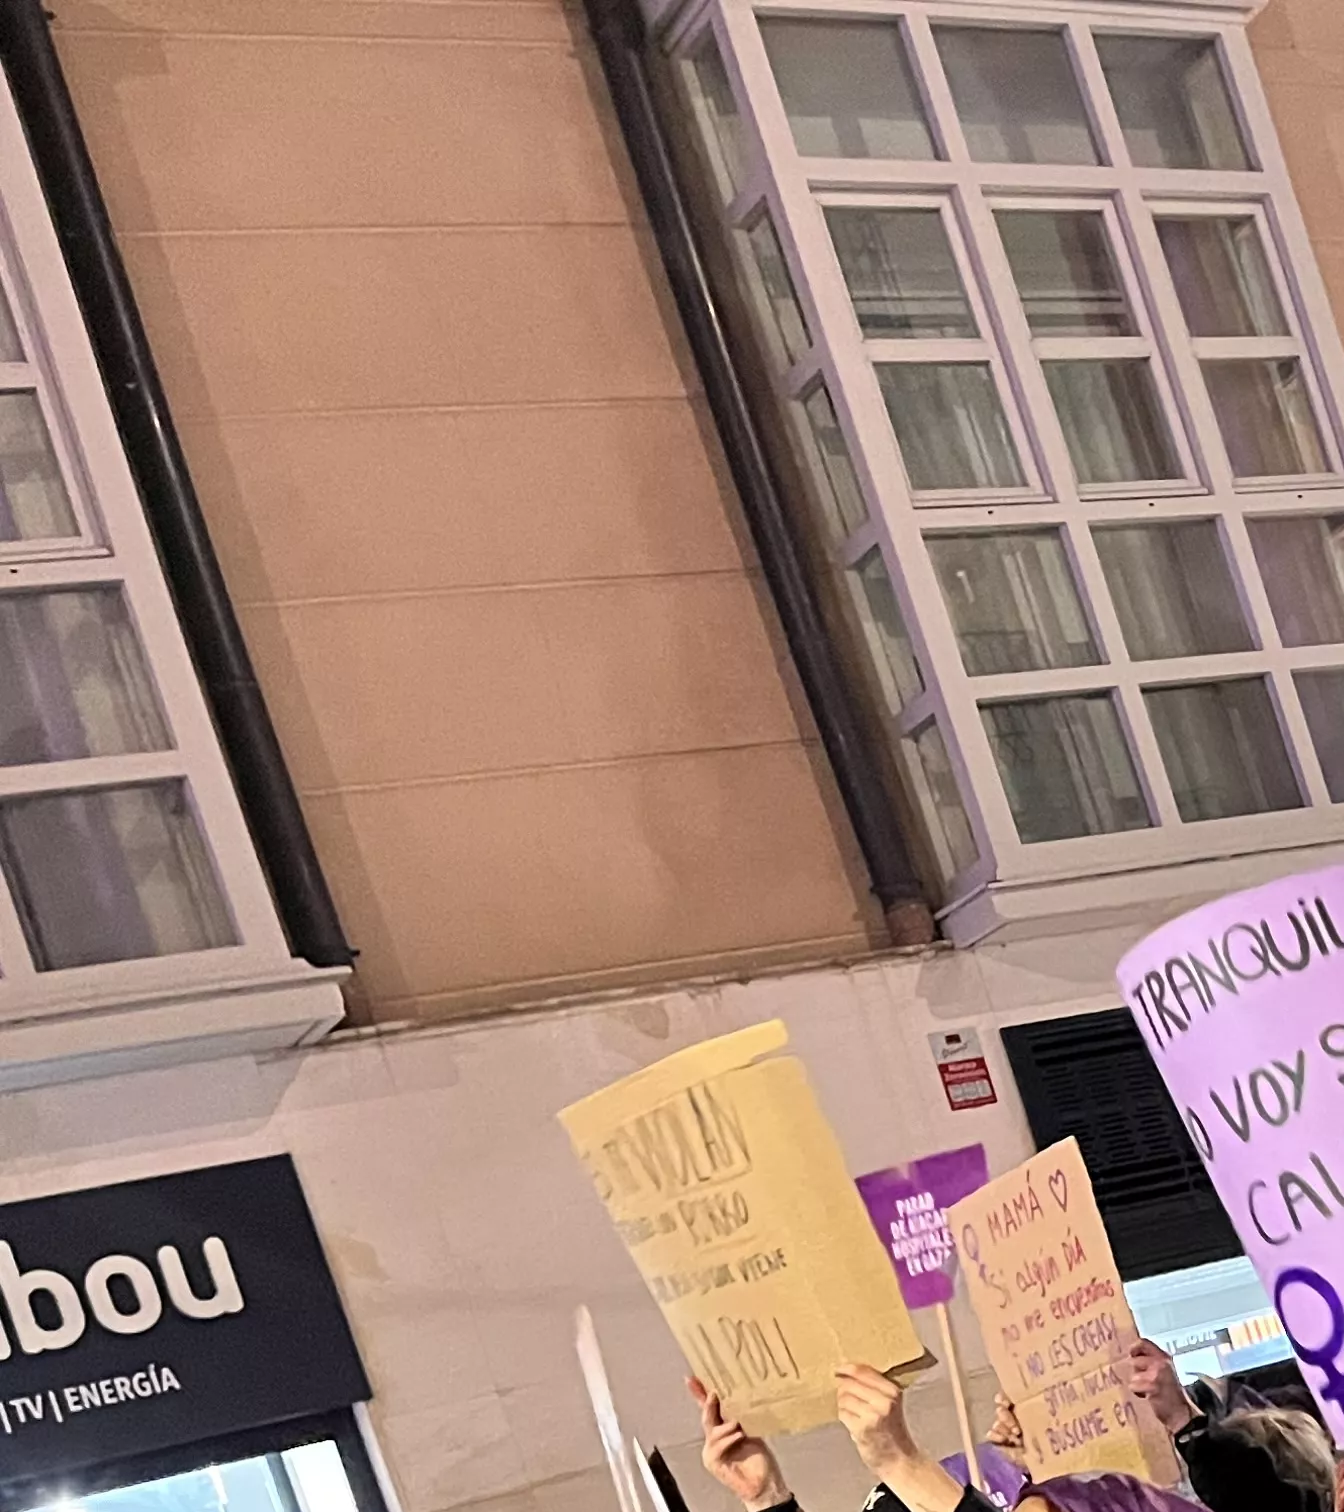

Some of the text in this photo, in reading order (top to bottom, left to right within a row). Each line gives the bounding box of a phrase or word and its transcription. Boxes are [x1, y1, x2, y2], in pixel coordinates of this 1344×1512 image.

[1209, 1049, 1307, 1143] VOY
[987, 1169, 1044, 1246] MAMÁ
[0, 1236, 245, 1361] bou
